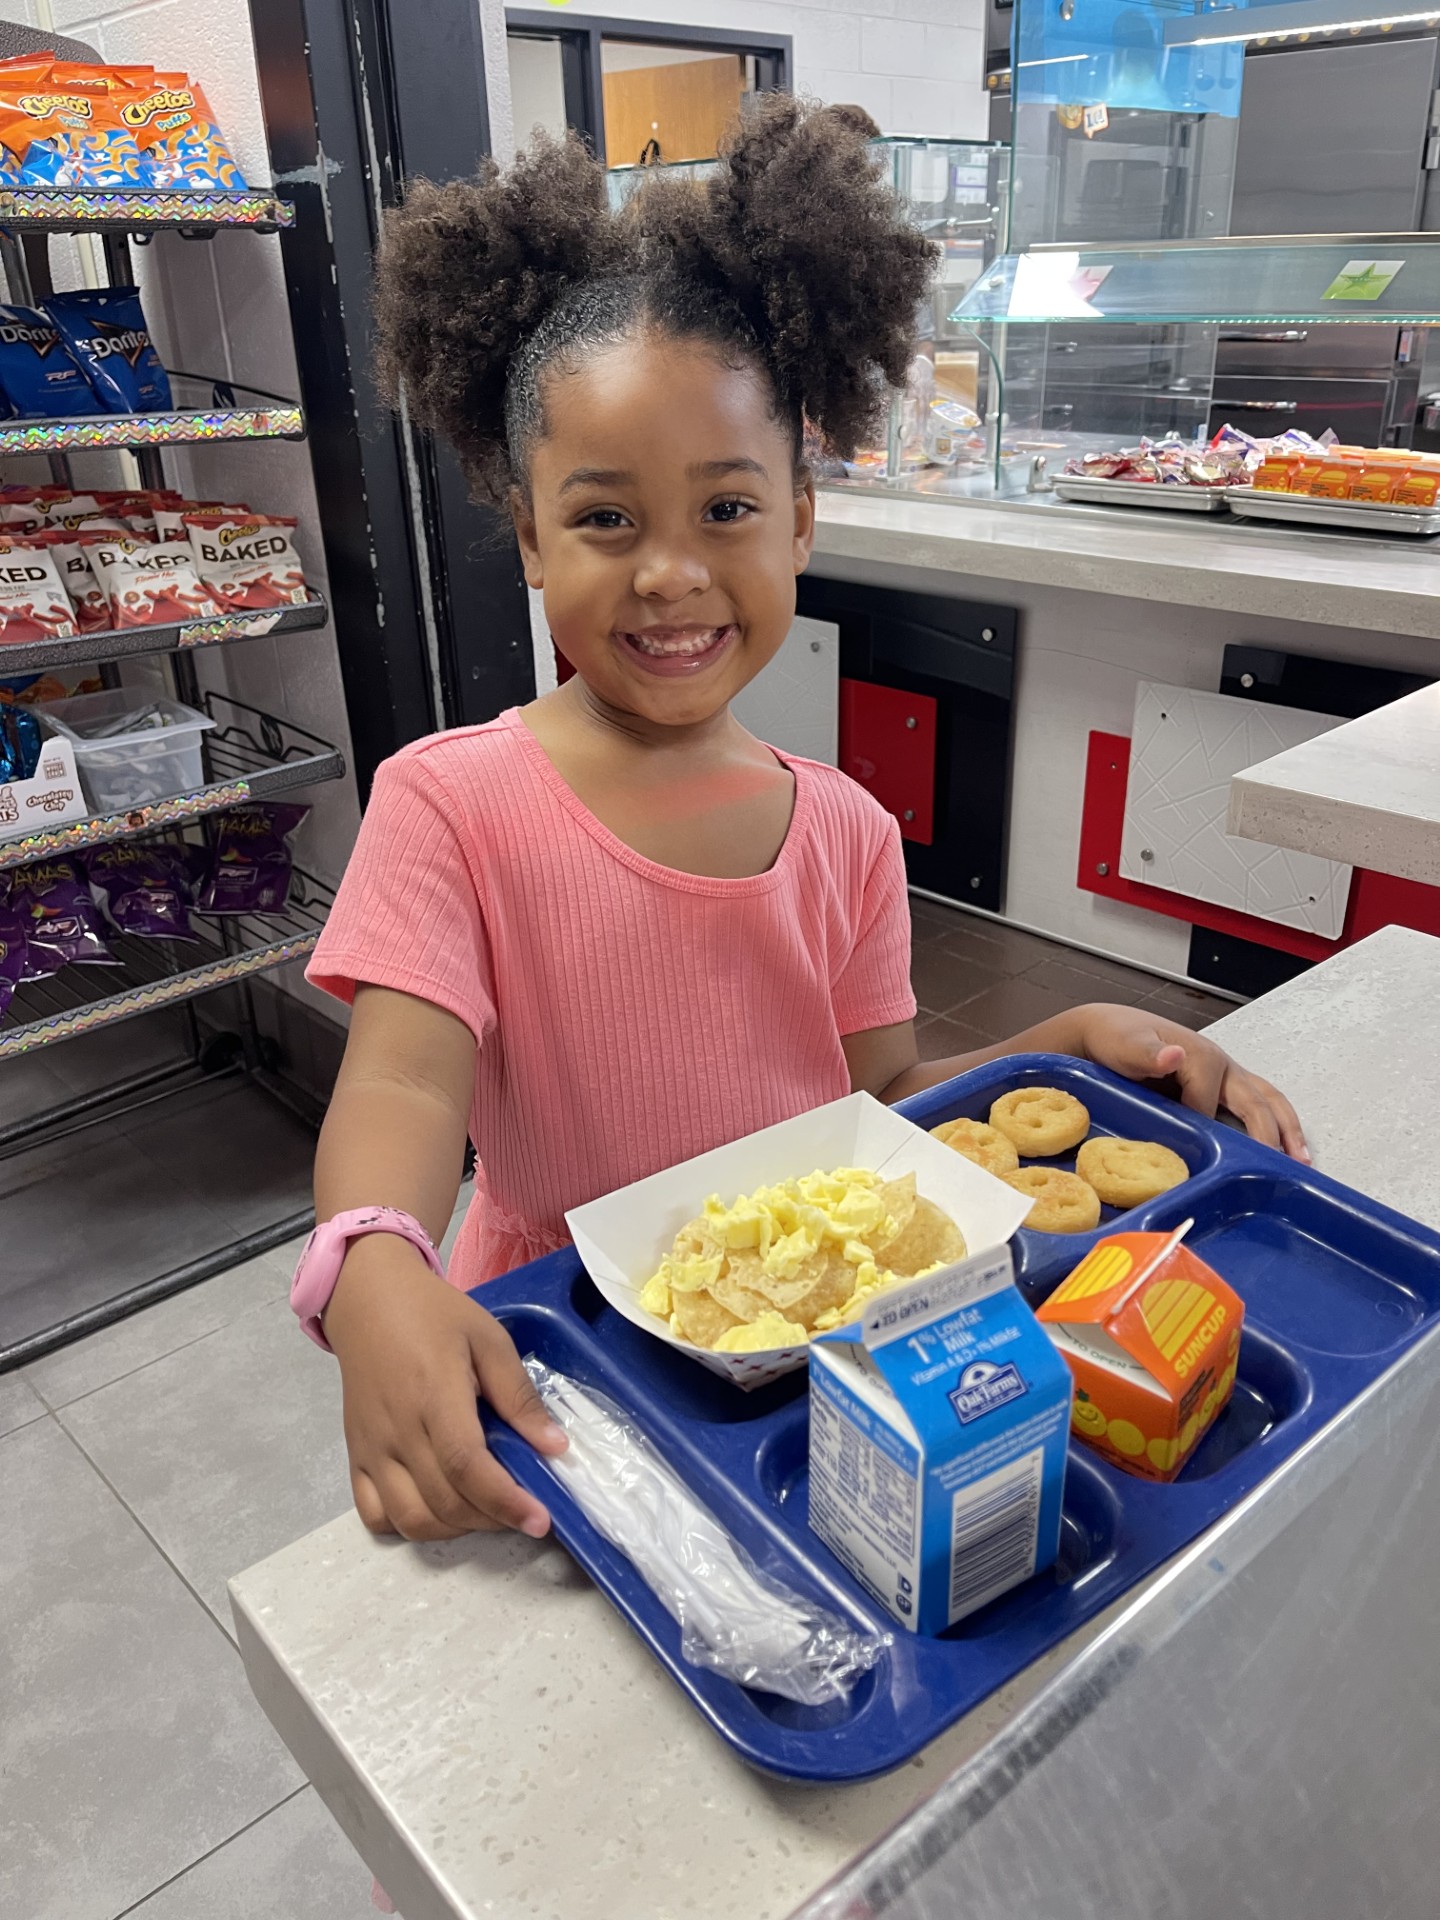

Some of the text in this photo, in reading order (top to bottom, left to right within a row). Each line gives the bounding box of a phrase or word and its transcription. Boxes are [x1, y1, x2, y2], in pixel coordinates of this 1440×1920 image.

[20, 95, 91, 117] Cheetos
[123, 91, 192, 125] Cheetos
[157, 113, 191, 131] Puffs
[0, 325, 60, 343] Dorit
[91, 330, 149, 359] Dorito
[201, 536, 288, 563] BAKED
[0, 566, 48, 583] KED
[44, 801, 66, 812] Chip
[933, 1308, 983, 1339] Lowfat
[943, 1331, 976, 1354] Milk
[1174, 1304, 1227, 1378] SUNCUP
[1072, 1338, 1127, 1370] TO OPEN
